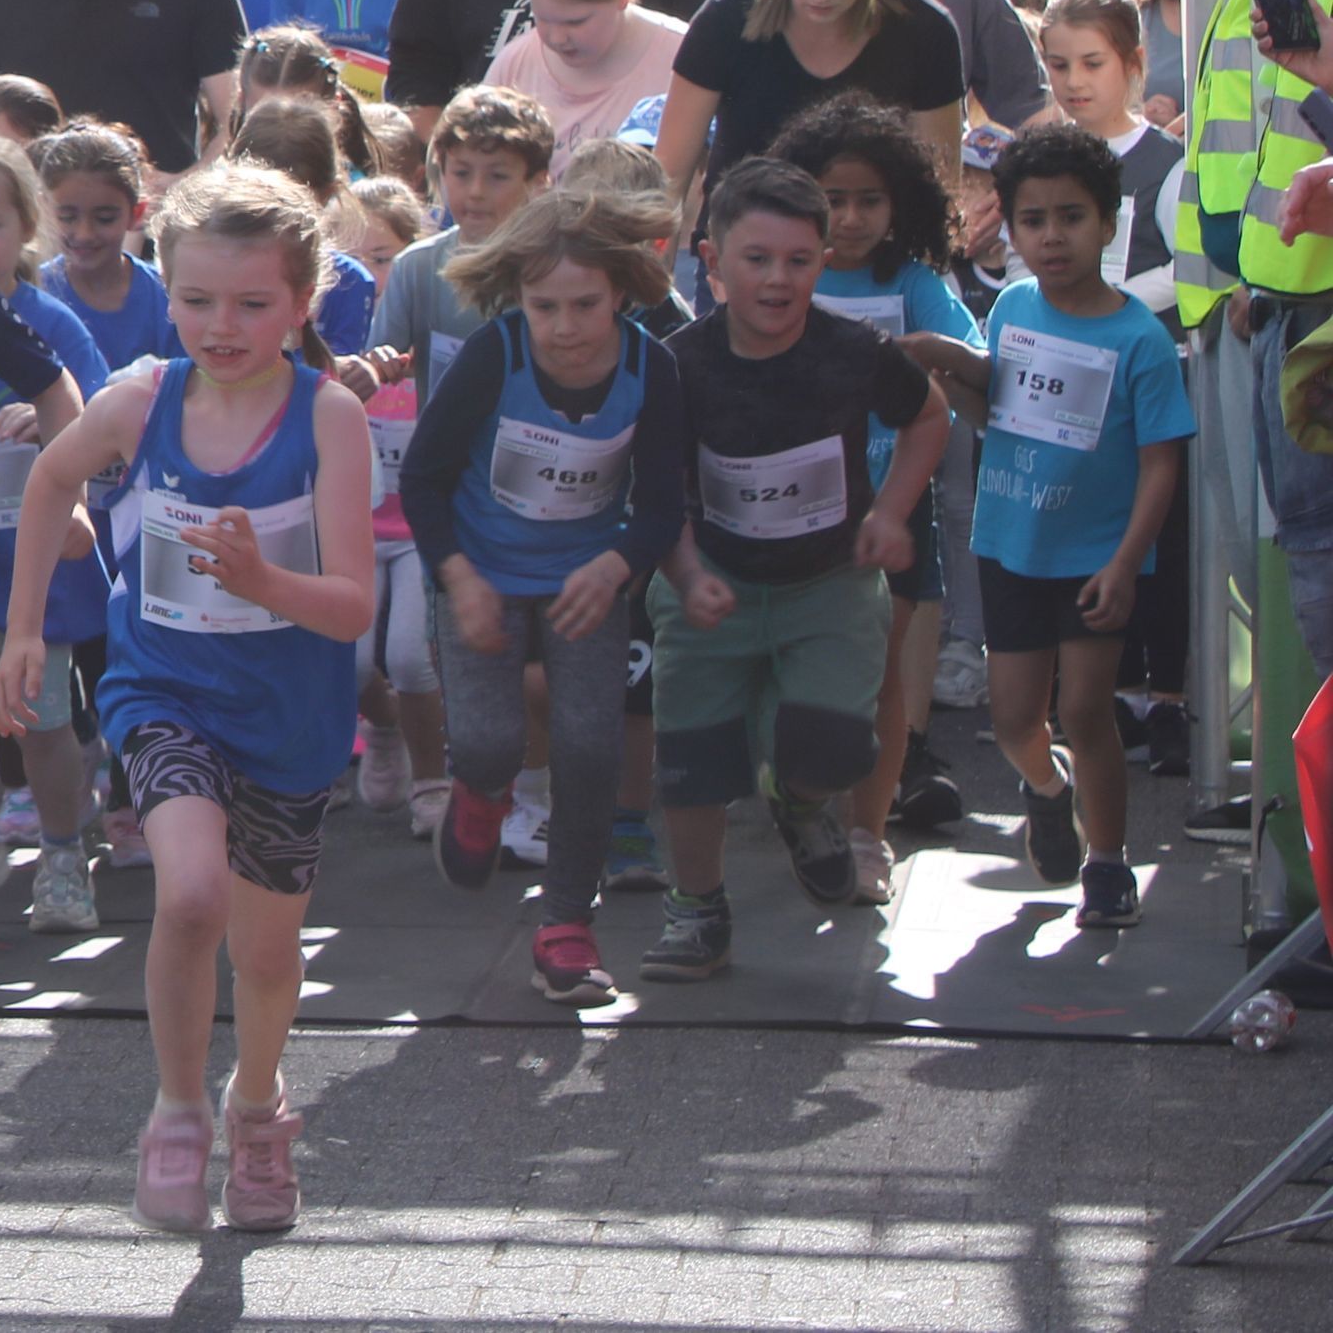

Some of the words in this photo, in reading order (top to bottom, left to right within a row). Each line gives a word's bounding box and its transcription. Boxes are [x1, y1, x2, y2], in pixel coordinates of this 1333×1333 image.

[1016, 369, 1065, 397] 158
[537, 467, 598, 484] 468
[739, 482, 801, 503] 524
[175, 509, 203, 526] ONI
